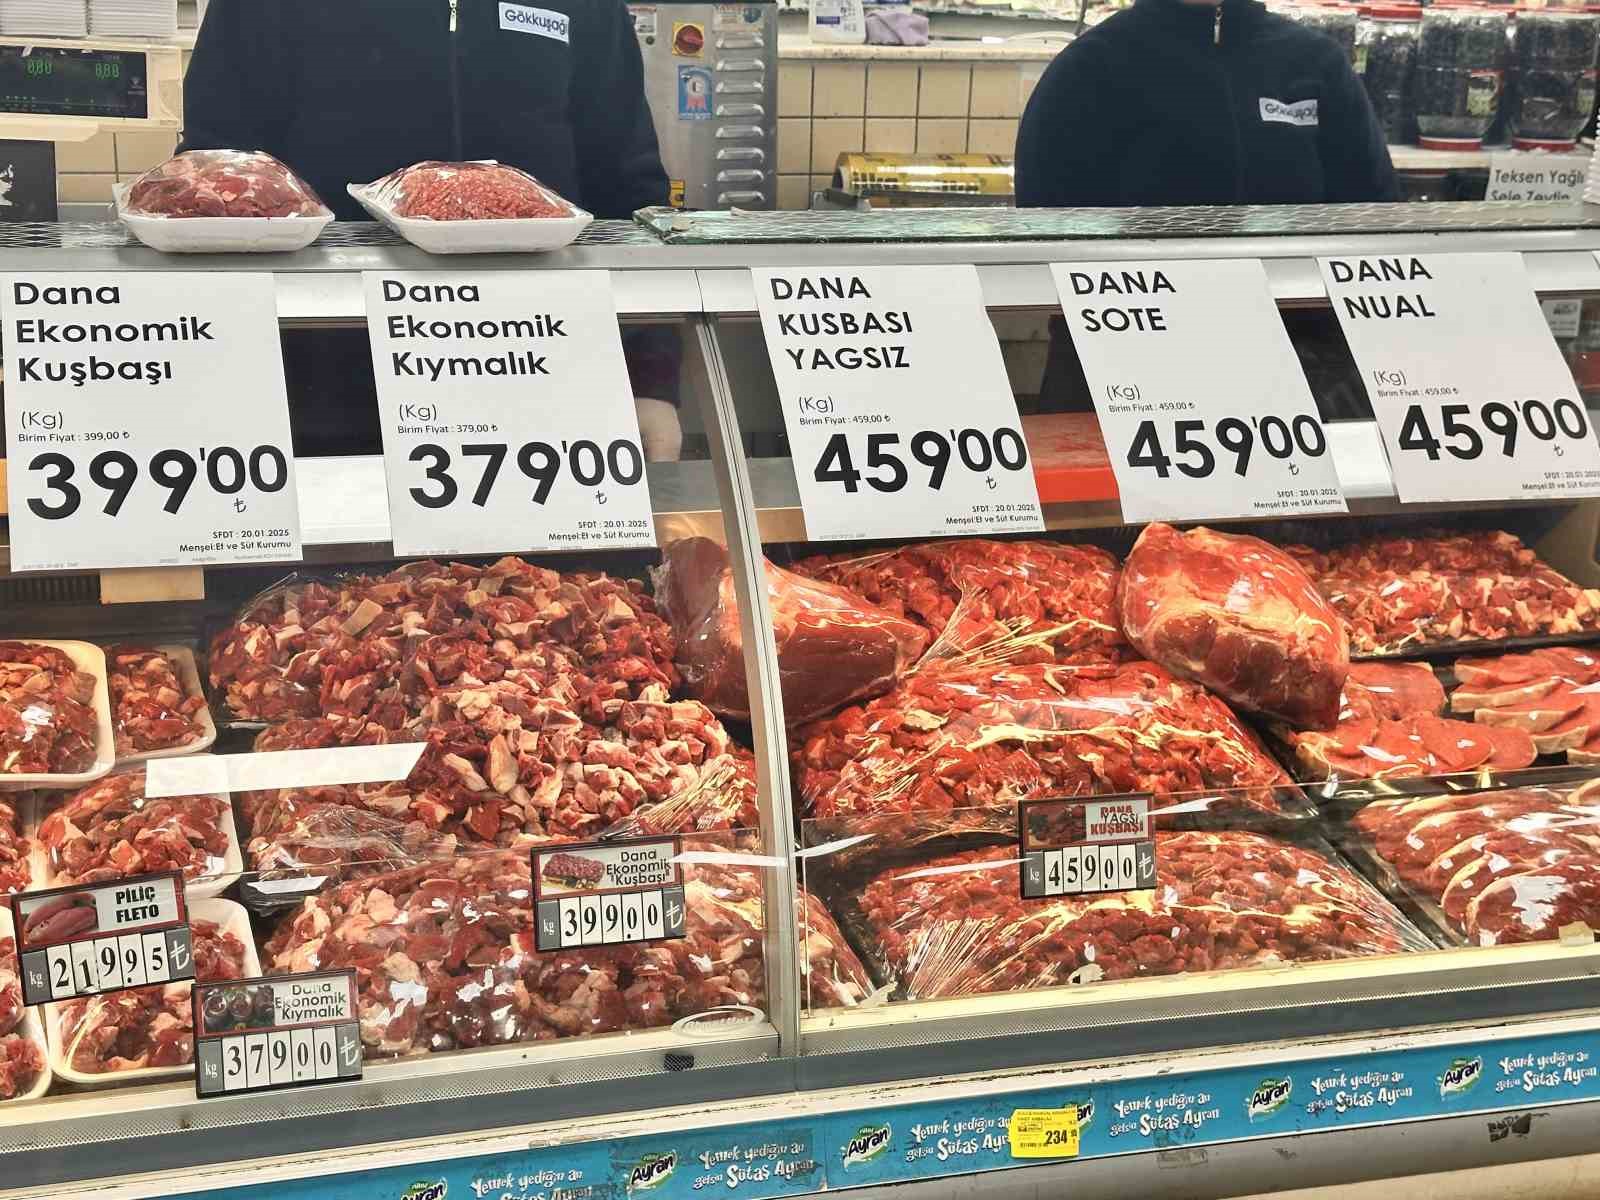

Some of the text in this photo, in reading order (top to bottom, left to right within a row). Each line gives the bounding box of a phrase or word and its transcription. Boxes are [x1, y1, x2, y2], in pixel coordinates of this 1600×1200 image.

[1496, 169, 1544, 184] Teksen
[1329, 258, 1432, 283] DANA
[382, 280, 480, 302] Dana
[770, 277, 872, 300] DANA
[1070, 271, 1176, 295] DANA
[14, 282, 120, 305] Dana
[1344, 294, 1436, 319] NUAL
[16, 316, 215, 343] Ekonomik
[388, 314, 568, 338] Ekonomik
[778, 312, 912, 336] KUSBASI
[1082, 308, 1166, 332] SOTE
[392, 352, 550, 382] Kıymalık
[786, 346, 910, 370] YAGSIZ
[18, 356, 172, 386] Kuşbaşı
[1374, 370, 1407, 386] (Kg)
[1106, 384, 1140, 400] (Kg)
[1378, 390, 1398, 398] Birim
[1400, 388, 1420, 397] Fiyat
[400, 404, 437, 422] (Kg)
[799, 396, 834, 414] (Kg)
[1109, 404, 1130, 412] Birim
[1133, 404, 1152, 412] Fiyat
[22, 411, 62, 430] (Kg)
[398, 425, 422, 434] Birim
[426, 425, 448, 434] Fiyat
[800, 417, 822, 426] Birim
[825, 416, 846, 426] Fiyat
[18, 433, 46, 442] Birim
[50, 433, 74, 443] Fiyat
[972, 504, 1036, 513] SFDT 20.01.2025
[241, 529, 289, 539] 20.01.2025
[578, 521, 596, 529] SFDT
[604, 531, 616, 539] Süt
[619, 530, 650, 538] Kurumu
[240, 541, 254, 550] Süt
[257, 540, 292, 548] Kurumu
[620, 849, 656, 863] Dana
[606, 858, 672, 876] Ekonomik
[1030, 868, 1040, 881] kg
[115, 886, 156, 905] PİLİÇ
[116, 904, 160, 924] FLETO
[543, 920, 554, 936] kg
[30, 970, 44, 988] kg
[282, 1004, 344, 1022] Kıymalık
[205, 1061, 218, 1078] kg
[1444, 1060, 1480, 1087] Ayran
[1500, 1054, 1534, 1075] Yemek
[1311, 1073, 1347, 1096] Yemek
[1564, 1066, 1598, 1086] Ayran
[1252, 1082, 1290, 1108] Ayran
[1378, 1086, 1412, 1106] Ayran
[1114, 1096, 1152, 1118] Yemek
[1183, 1108, 1220, 1128] Ayran
[848, 1127, 888, 1155] Ayran
[911, 1120, 950, 1142] Yemek
[1046, 1130, 1068, 1145] 234
[699, 1146, 738, 1170] Yemek
[631, 1154, 674, 1185] Ayran
[773, 1159, 814, 1179] Ayran
[470, 1173, 514, 1198] Yemek
